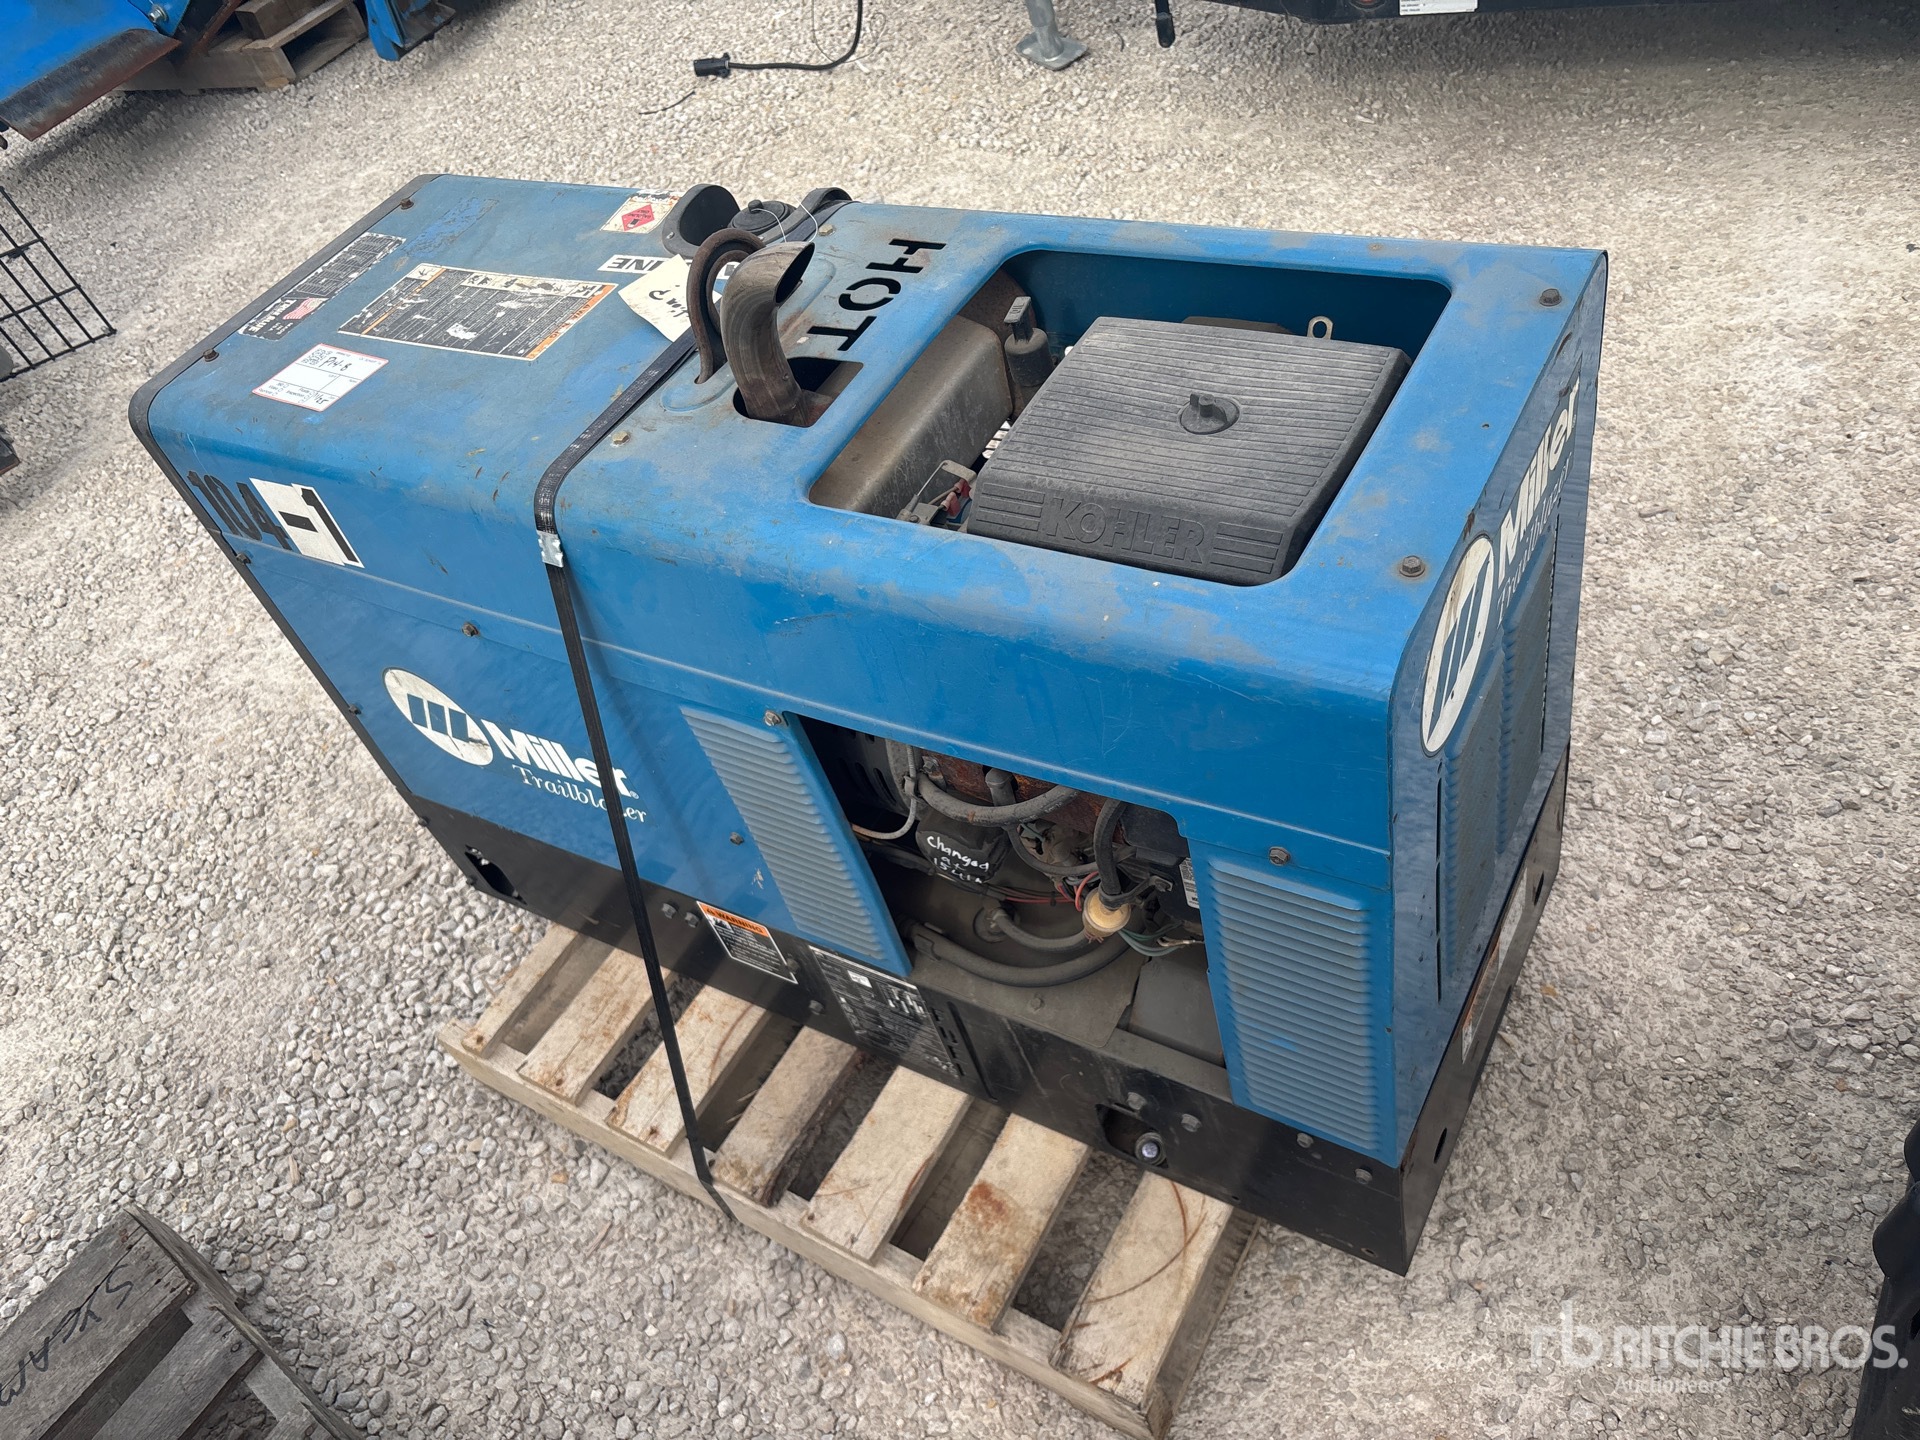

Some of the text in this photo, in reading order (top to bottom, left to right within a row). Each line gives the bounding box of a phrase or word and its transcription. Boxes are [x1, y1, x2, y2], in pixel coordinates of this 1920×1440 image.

[806, 238, 947, 351] HOT
[187, 470, 359, 563] 104-1
[1498, 376, 1580, 589] Miller
[1047, 498, 1204, 563] KOHLER
[481, 718, 634, 798] Miller
[926, 835, 990, 873] Changed
